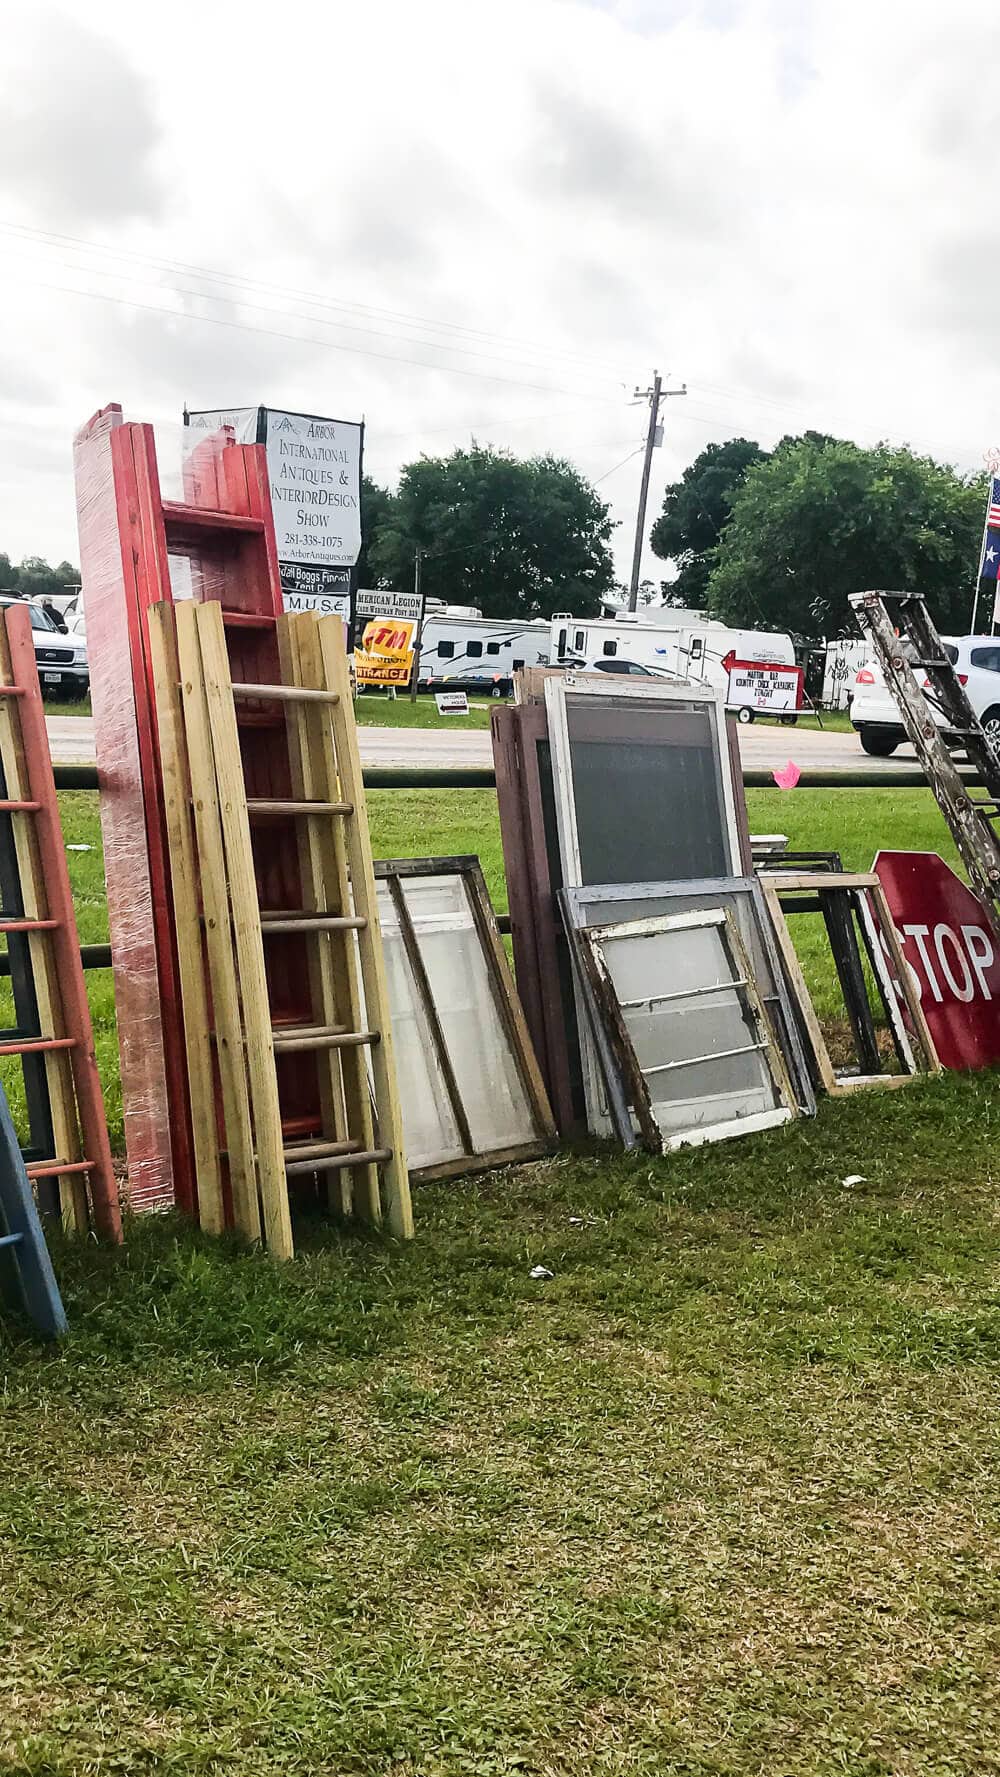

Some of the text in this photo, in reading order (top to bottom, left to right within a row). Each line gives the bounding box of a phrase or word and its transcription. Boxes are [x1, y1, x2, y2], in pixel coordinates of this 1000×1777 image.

[307, 423, 336, 440] ARBOR
[279, 438, 349, 463] INTERNATIONAL
[280, 462, 349, 485] ANTIQUES &
[296, 509, 330, 527] SHOW
[284, 532, 343, 548] 281-338-1075
[280, 566, 295, 579] dall
[296, 568, 321, 584] Boggs
[295, 581, 314, 592] Tent
[358, 593, 421, 608] MERICAN LEGION
[357, 668, 406, 679] NTRANCE
[879, 922, 994, 1003] STOP
